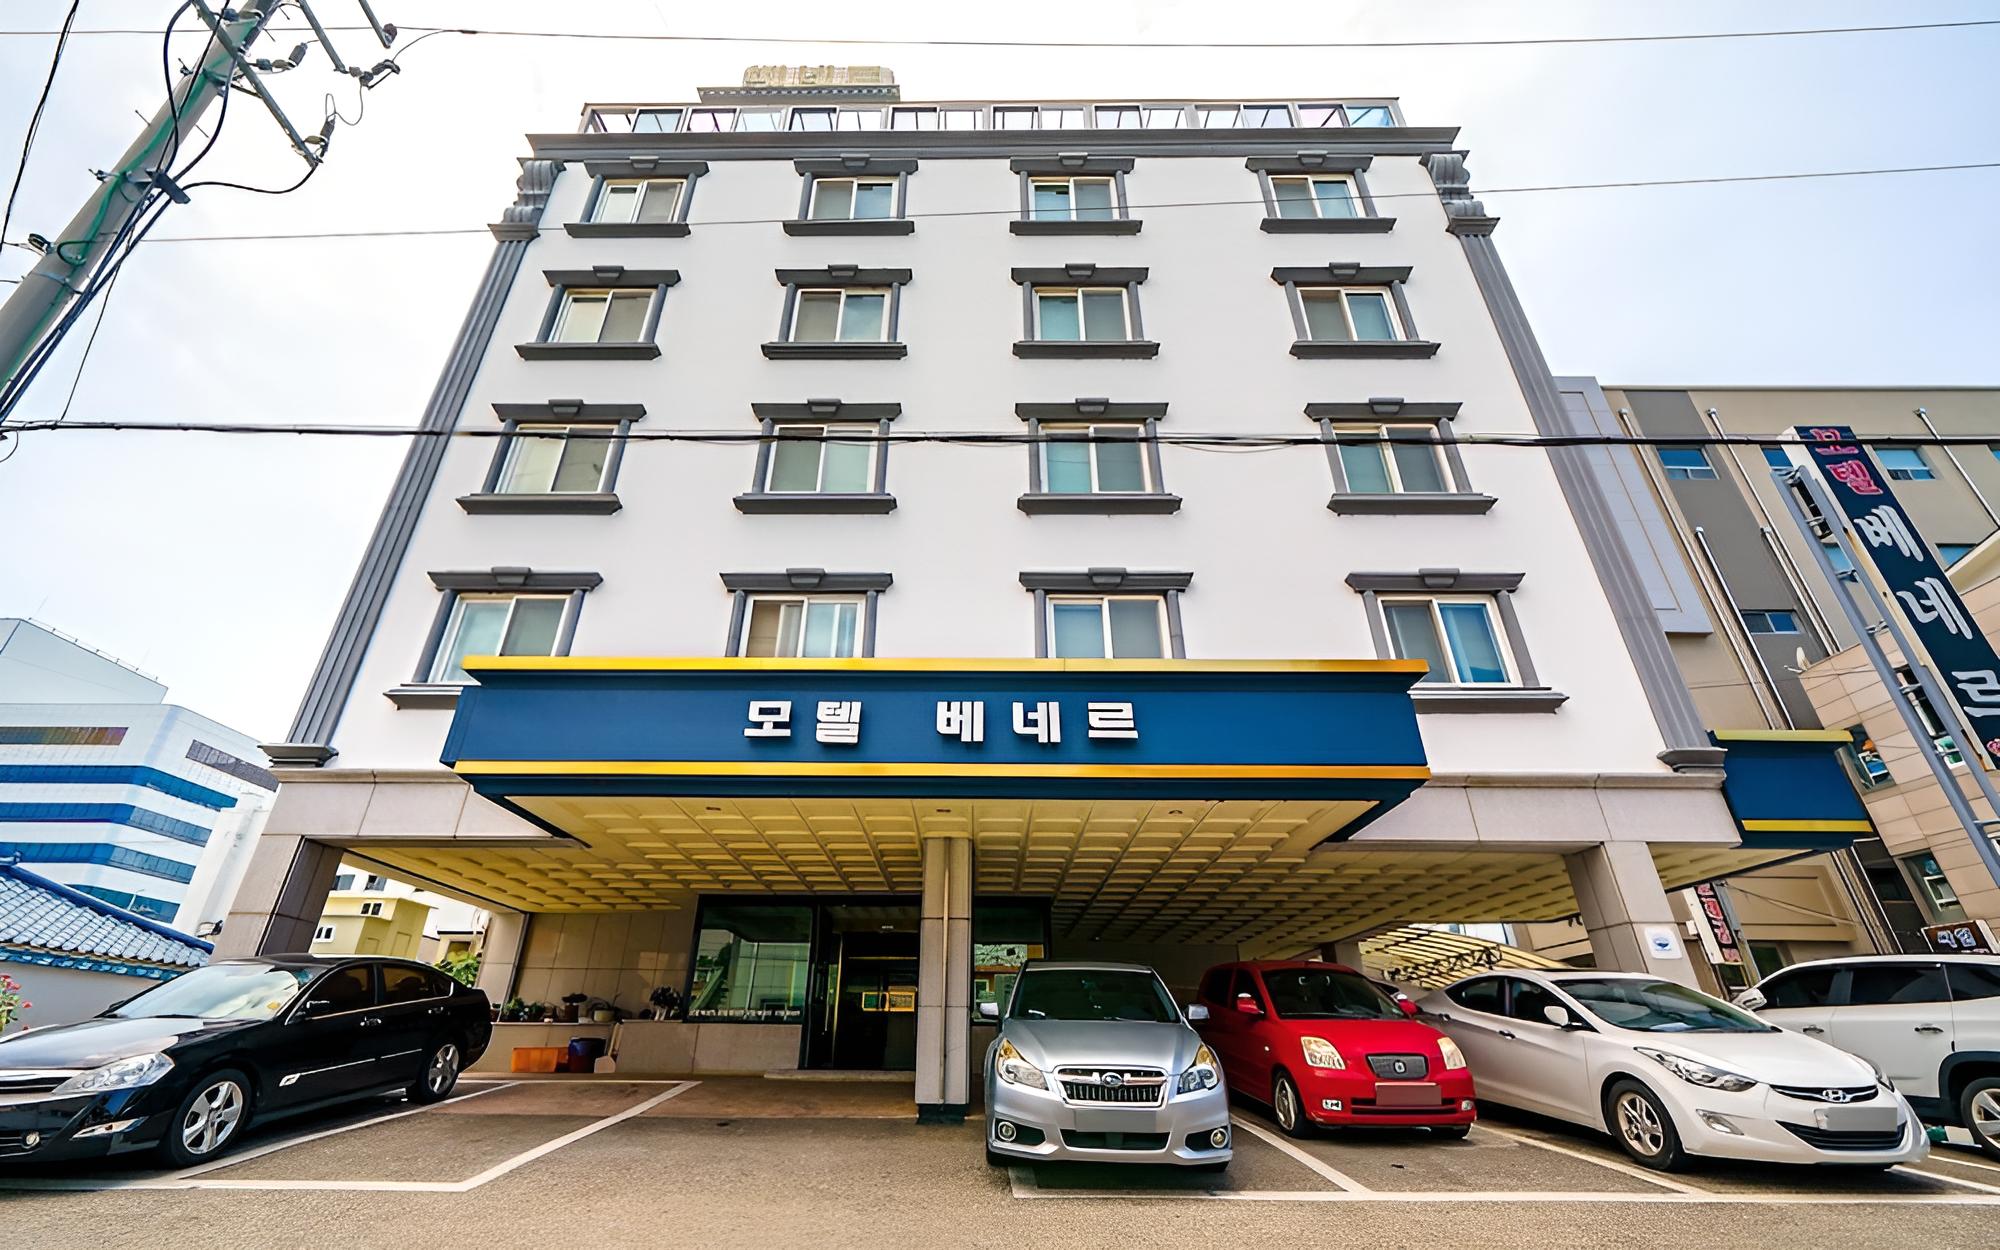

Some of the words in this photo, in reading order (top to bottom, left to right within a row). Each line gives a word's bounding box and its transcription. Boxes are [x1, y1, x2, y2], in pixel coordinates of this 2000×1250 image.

[1809, 427, 1884, 496] 모텔
[743, 700, 862, 744] 모텔
[935, 700, 1139, 743] 베네르
